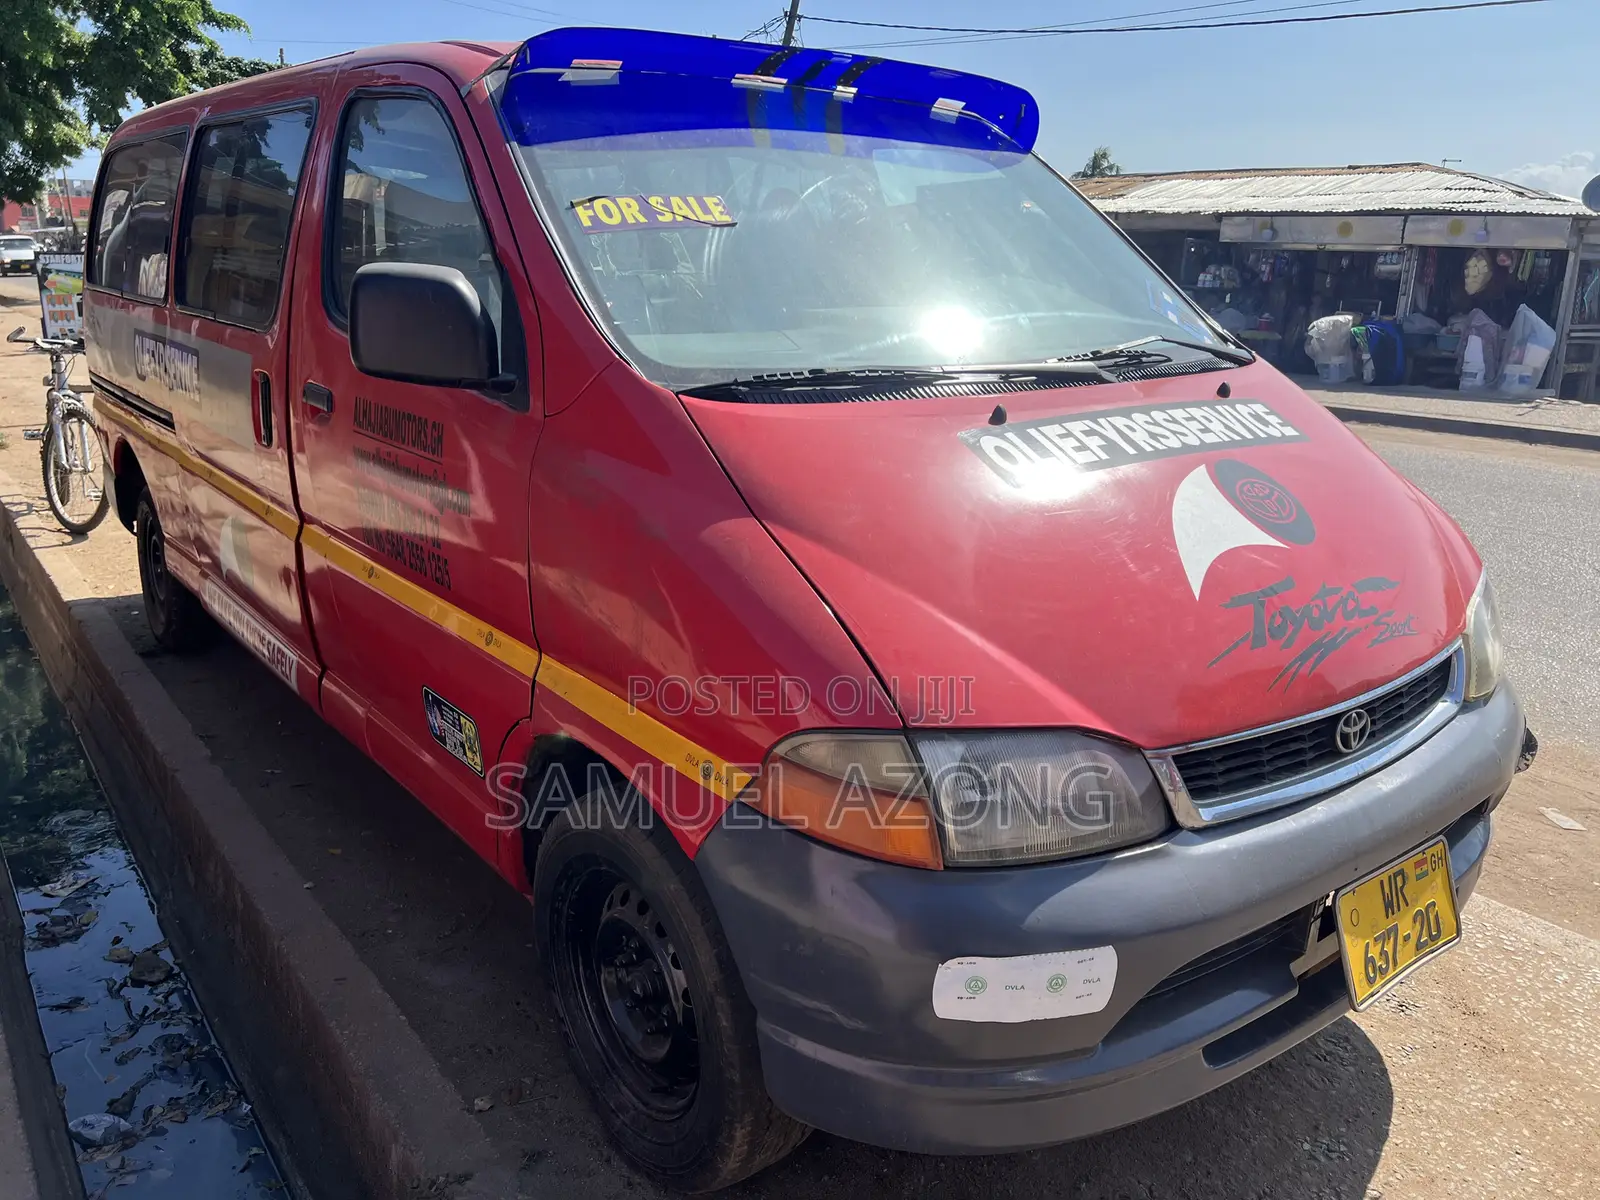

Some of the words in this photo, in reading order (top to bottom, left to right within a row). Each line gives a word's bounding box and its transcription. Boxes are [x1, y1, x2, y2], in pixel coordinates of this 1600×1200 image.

[575, 197, 648, 227] FOR
[648, 195, 732, 223] SALE
[353, 396, 444, 458] ALHAJIABUMOTORS.GH
[1219, 576, 1400, 651] Toyota
[266, 639, 295, 684] SAFELY
[685, 752, 700, 769] DVLA
[714, 771, 729, 788] DVLA
[1430, 848, 1444, 873] GH
[1379, 867, 1409, 920] WR
[1363, 899, 1443, 986] 637-20
[1082, 977, 1101, 985] DVLA
